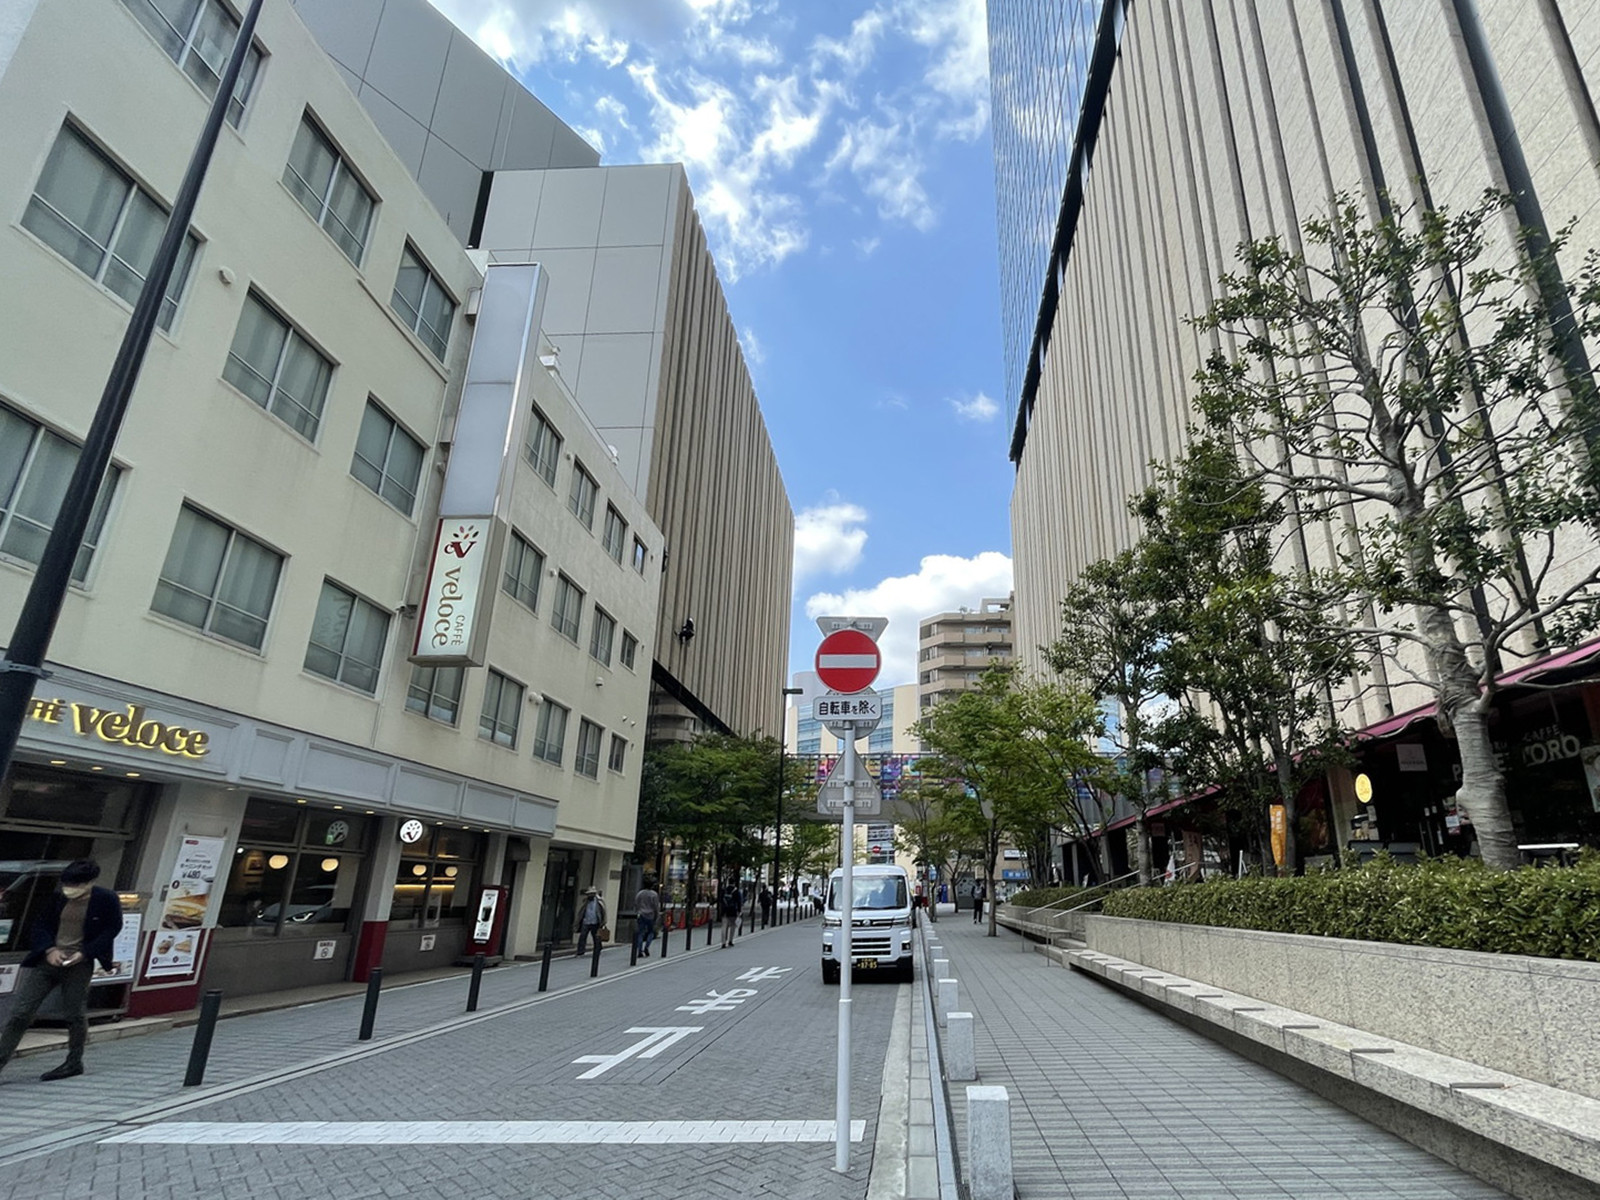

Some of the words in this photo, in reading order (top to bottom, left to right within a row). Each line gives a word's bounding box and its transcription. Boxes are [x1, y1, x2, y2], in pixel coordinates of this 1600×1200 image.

[432, 566, 463, 649] veloce
[818, 701, 876, 716] 自転車を除く
